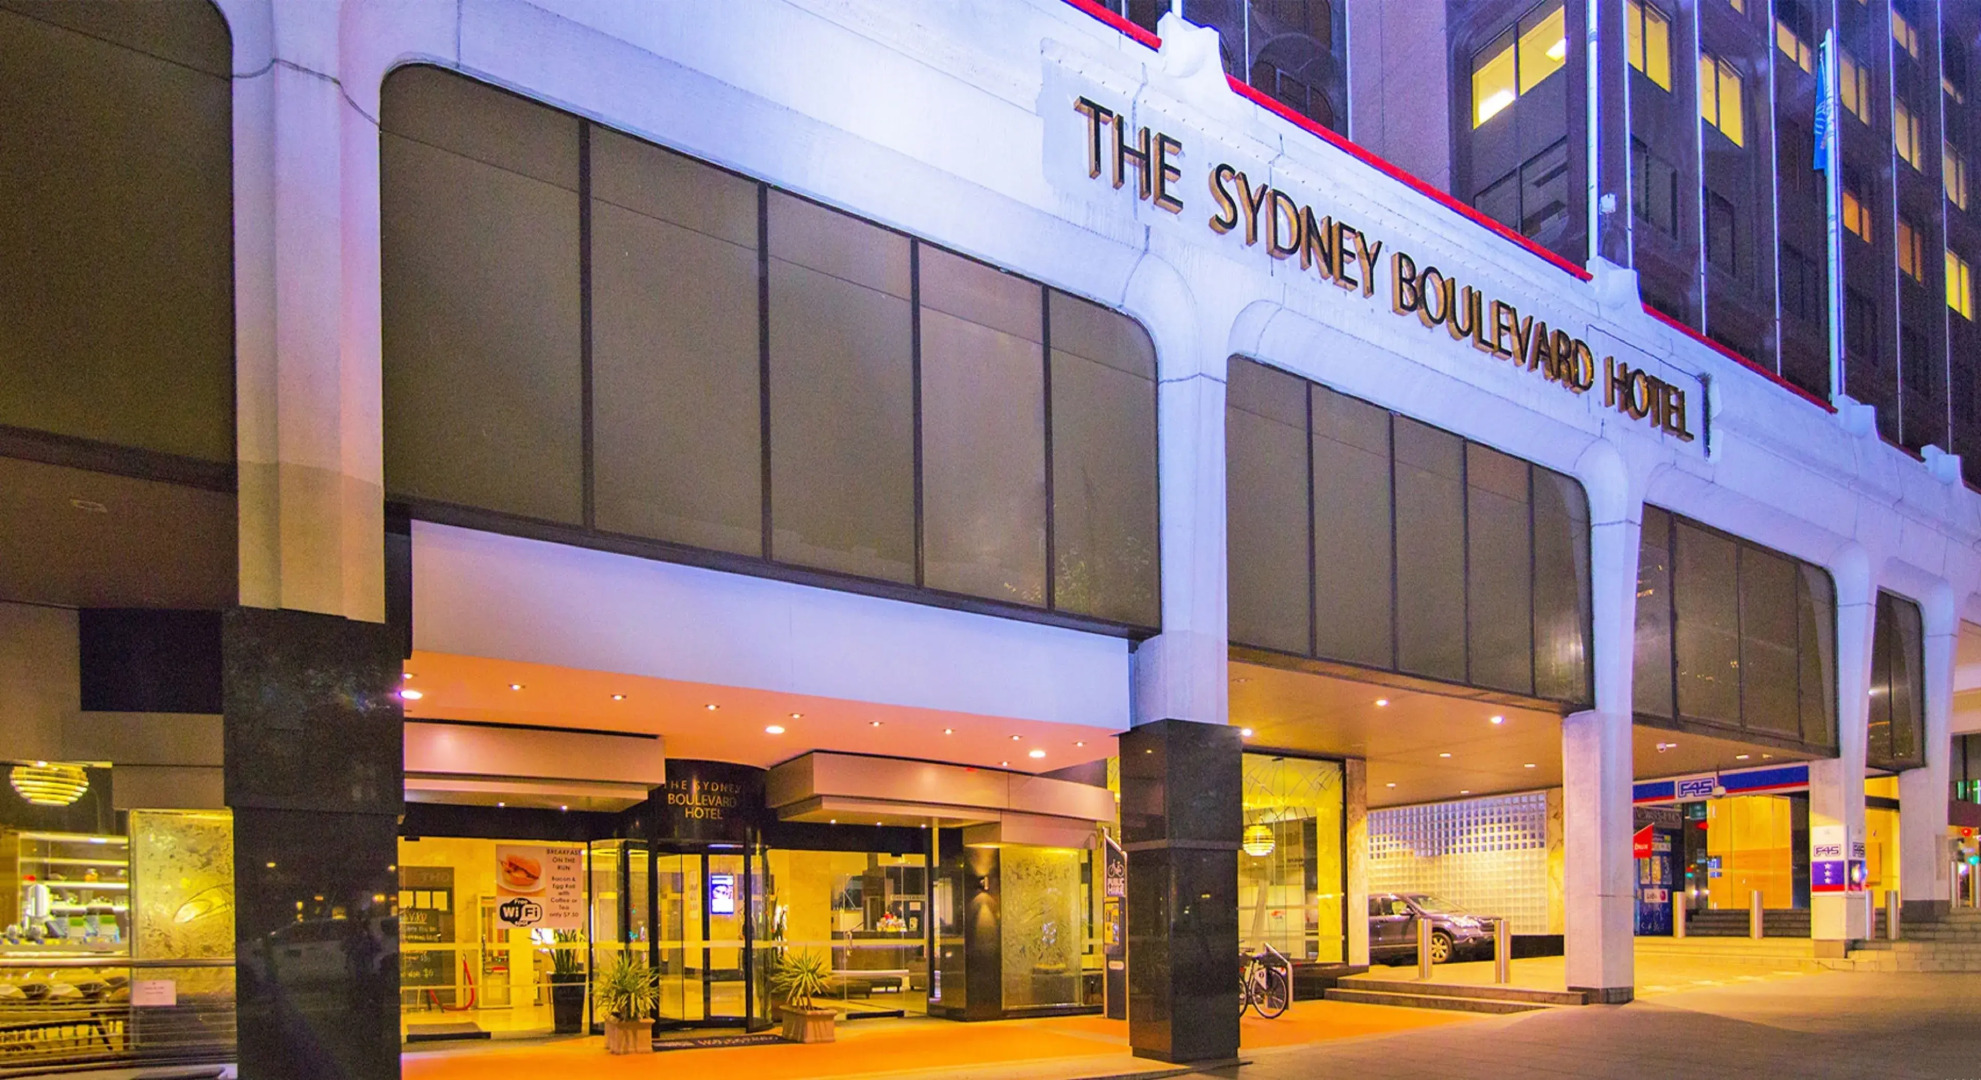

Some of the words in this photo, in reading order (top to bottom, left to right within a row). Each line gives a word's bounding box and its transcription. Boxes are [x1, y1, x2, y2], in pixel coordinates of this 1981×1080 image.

[1074, 95, 1184, 214] THE
[1208, 163, 1382, 298] SYDNEY
[1391, 252, 1594, 394] BOULEVARD
[1603, 356, 1694, 442] HOTEL
[694, 780, 742, 793] SYDNEY
[1679, 780, 1714, 797] F45
[668, 793, 738, 807] BOULEVARD
[685, 807, 723, 819] HOTEL
[1814, 844, 1841, 857] F45
